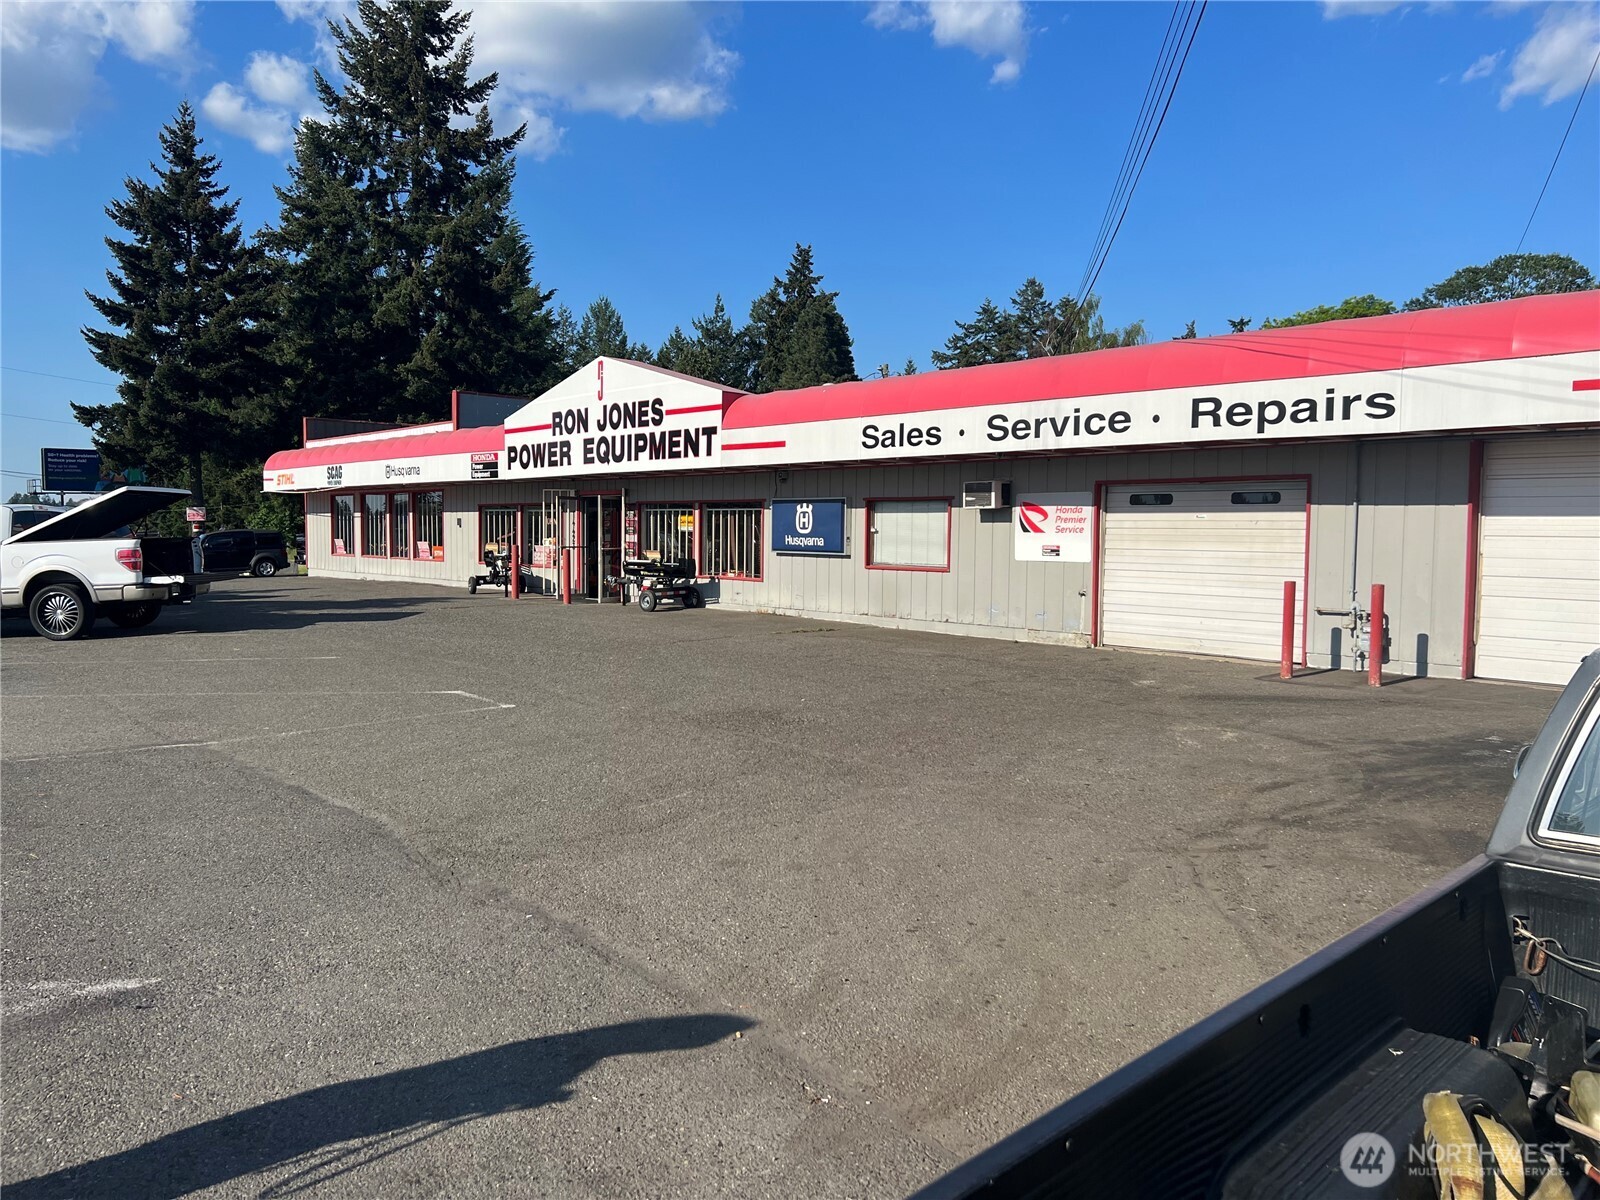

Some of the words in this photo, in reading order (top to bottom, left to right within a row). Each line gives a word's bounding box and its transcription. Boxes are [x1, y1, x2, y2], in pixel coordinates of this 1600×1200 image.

[552, 407, 589, 436] RON
[597, 398, 664, 432] JONES
[862, 424, 941, 449] Sales
[987, 407, 1132, 442] Service
[1192, 389, 1396, 432] Repairs
[507, 440, 572, 470] POWER
[583, 426, 718, 465] EQUIPMENT
[472, 453, 495, 462] HONDA
[327, 465, 343, 480] SCAG
[390, 465, 420, 478] Husqvarna
[277, 473, 295, 486] STIHL
[1055, 506, 1083, 514] Honda
[1055, 516, 1087, 524] Premier
[1055, 525, 1085, 534] Service
[785, 535, 824, 547] Husqvarna
